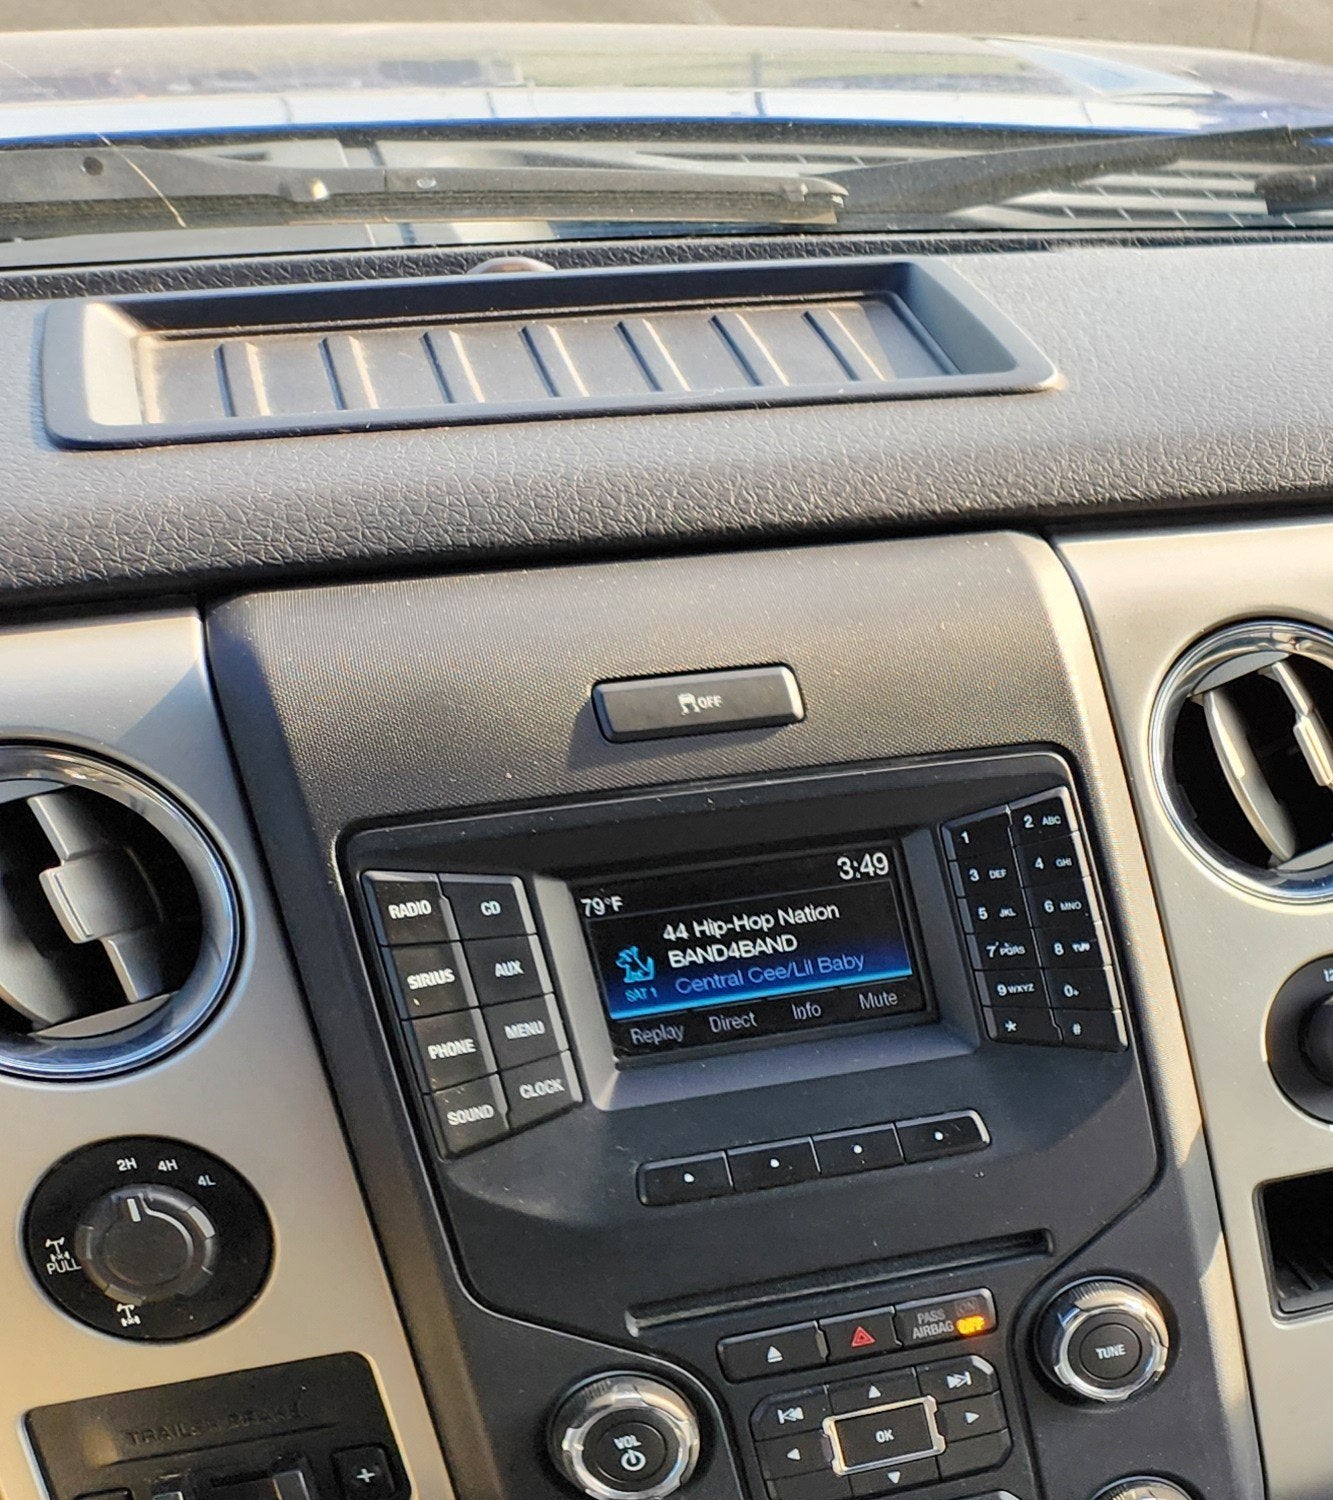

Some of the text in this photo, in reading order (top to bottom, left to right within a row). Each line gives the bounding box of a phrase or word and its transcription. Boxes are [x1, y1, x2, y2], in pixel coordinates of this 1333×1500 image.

[697, 693, 723, 709] OFF
[1023, 814, 1062, 829] 2 ABC
[960, 830, 971, 845] 1
[836, 851, 890, 881] 3:49
[1034, 856, 1045, 870] 4
[968, 867, 1008, 882] 3 DEF
[388, 899, 432, 919] RADIO
[480, 900, 502, 917] CD
[977, 906, 1017, 920] 5 JKL
[1043, 899, 1083, 914] 6 MNO
[662, 902, 841, 942] 44 Hip-Hop Nation
[667, 933, 798, 968] BAND4BAND
[986, 944, 996, 959] 7
[1053, 941, 1065, 956] 8
[494, 959, 525, 978] AUX
[675, 952, 866, 995] Central Cee/Lil Baby
[407, 967, 456, 990] SIRIUS
[996, 982, 1035, 997] 9 WXYZ
[858, 990, 899, 1011] Mute
[791, 1001, 822, 1021] Info
[503, 1019, 547, 1040] MENU
[709, 1010, 758, 1033] Direct
[629, 1022, 685, 1046] Replay
[427, 1037, 478, 1060] PHONE
[518, 1077, 566, 1099] CLOCK
[446, 1103, 495, 1126] SOUND
[116, 1156, 139, 1172] 2H
[156, 1158, 180, 1173] 4H
[197, 1174, 217, 1187] 4L
[46, 1257, 83, 1276] PULL
[917, 1308, 947, 1326] PASS
[956, 1315, 986, 1337] OFF
[911, 1319, 955, 1340] AIRBAG
[1095, 1343, 1128, 1360] TUNE
[613, 1434, 643, 1451] VOL
[874, 1428, 895, 1444] OK
